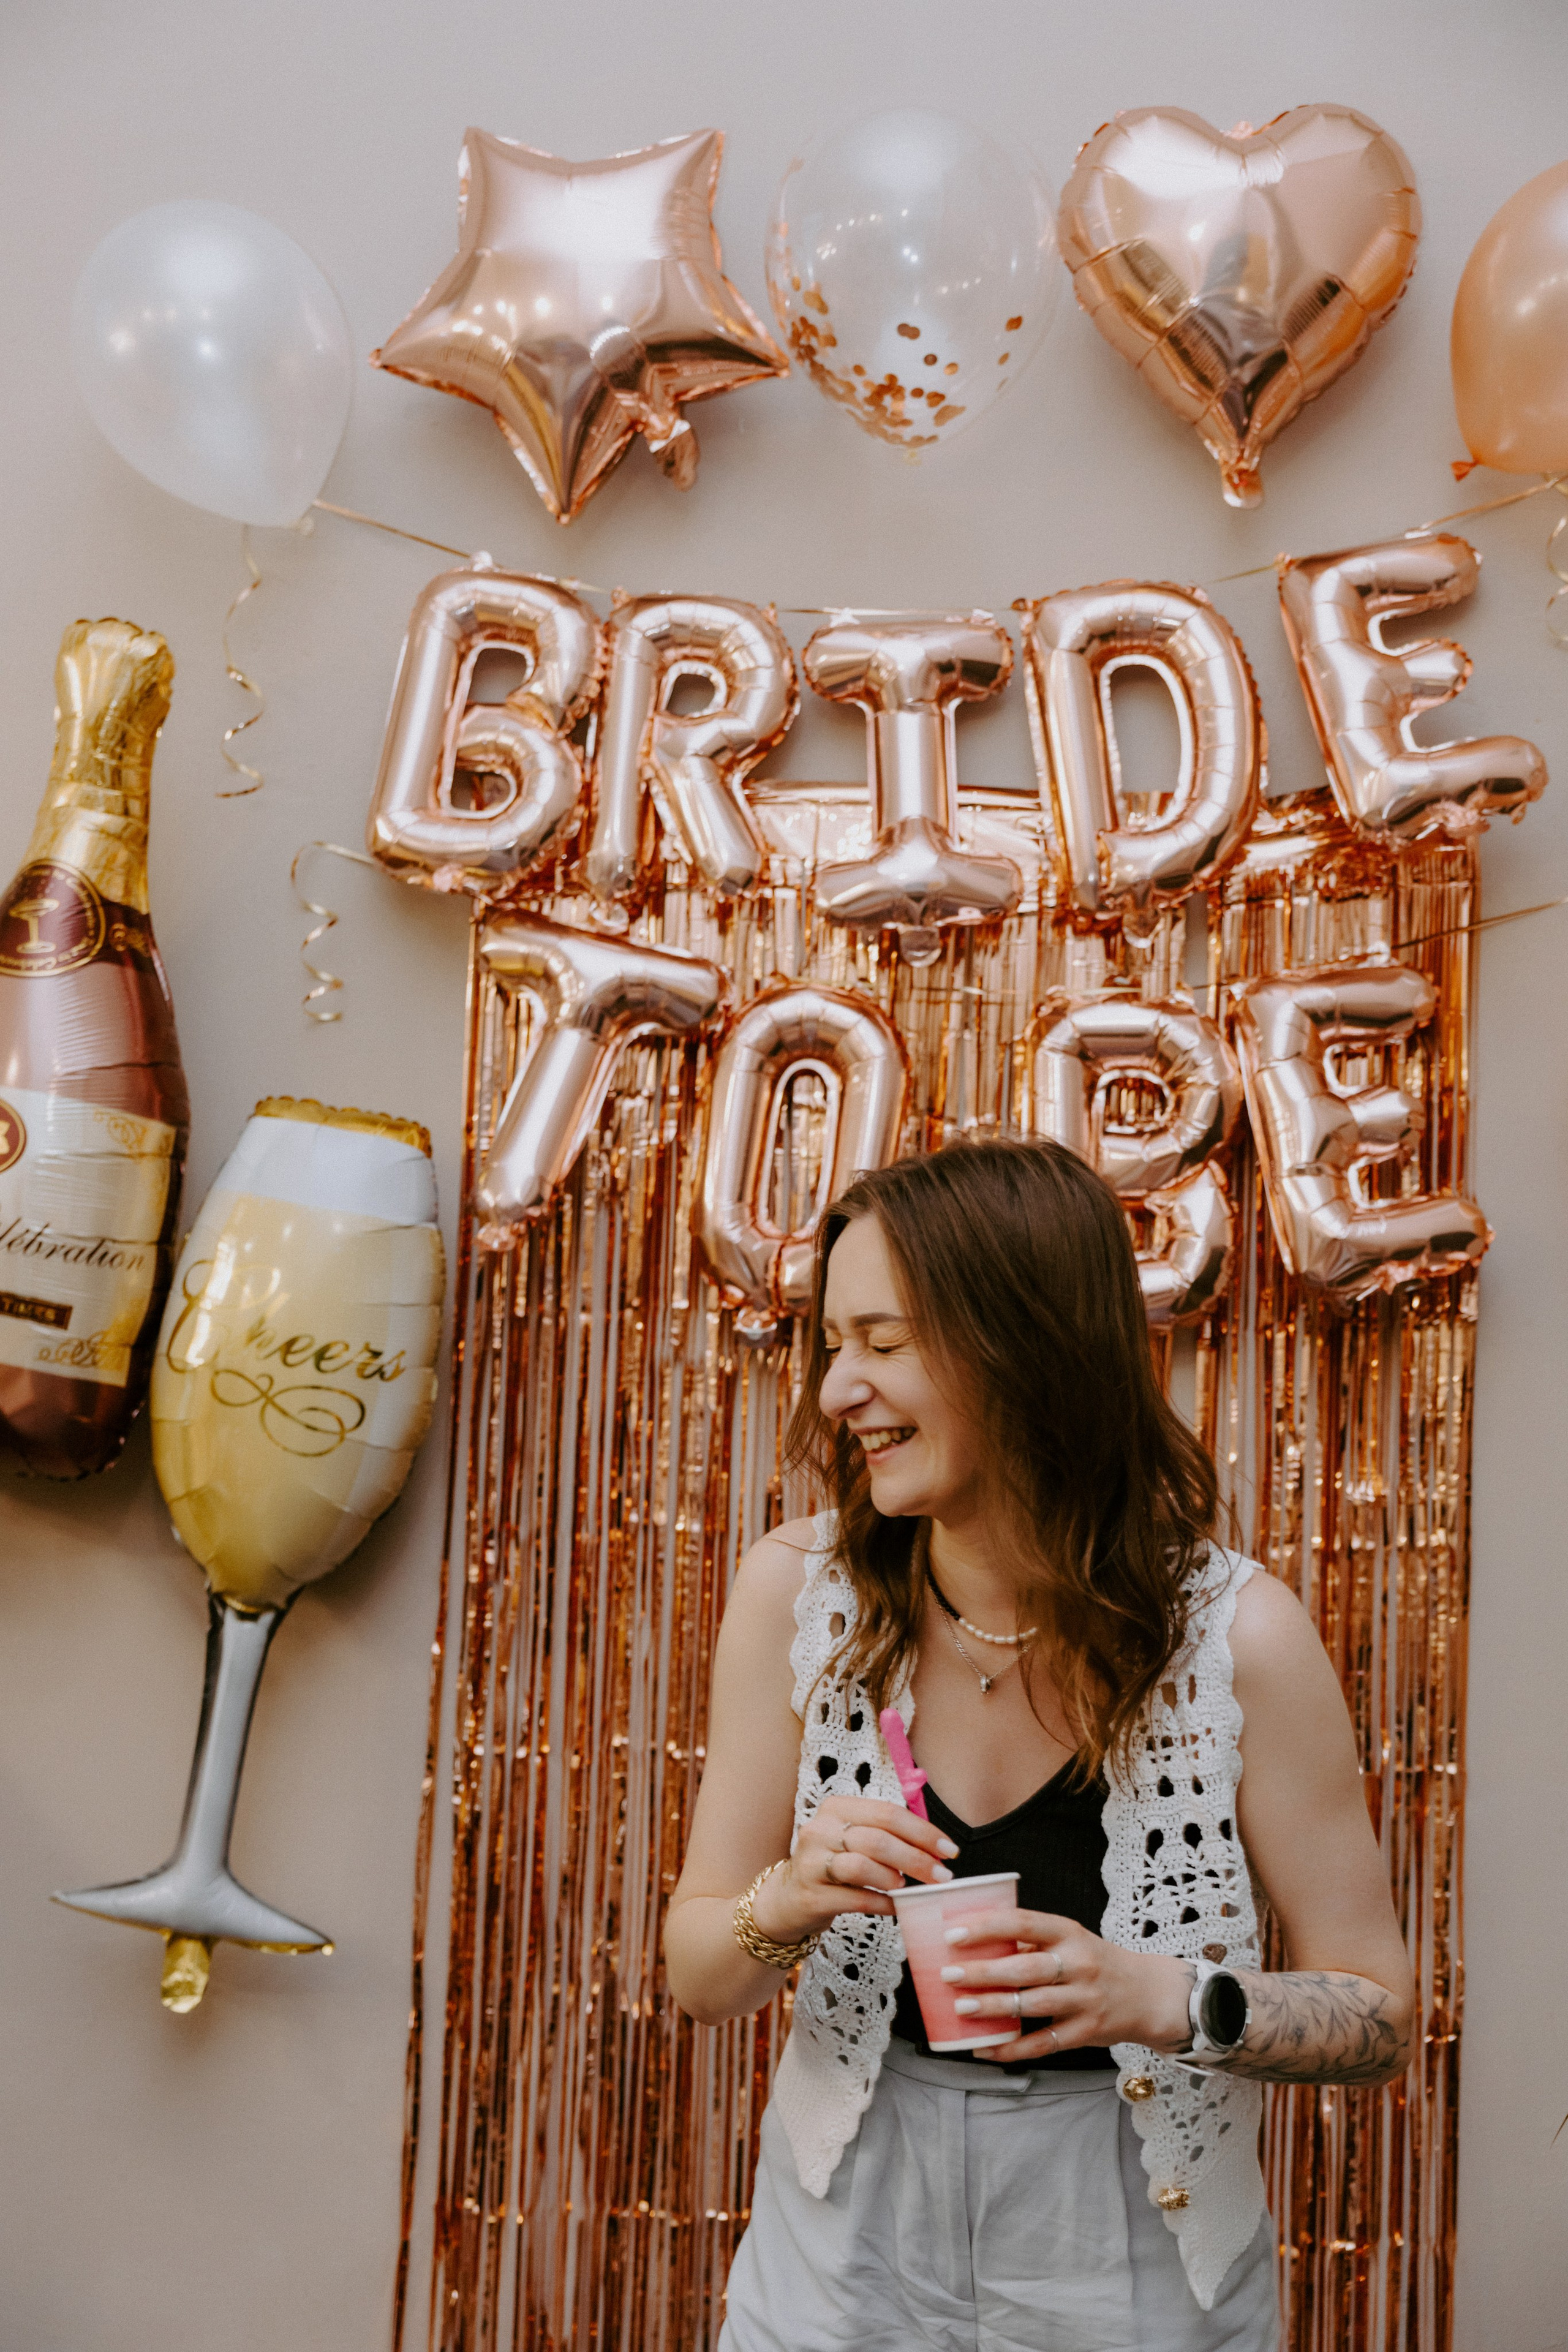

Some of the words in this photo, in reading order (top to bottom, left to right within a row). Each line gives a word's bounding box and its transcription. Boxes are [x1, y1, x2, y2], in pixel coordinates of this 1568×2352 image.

[368, 527, 1548, 928] BRIDE
[472, 907, 911, 1323] TO
[1024, 962, 1494, 1329] BE
[167, 1259, 406, 1382] Cheers
